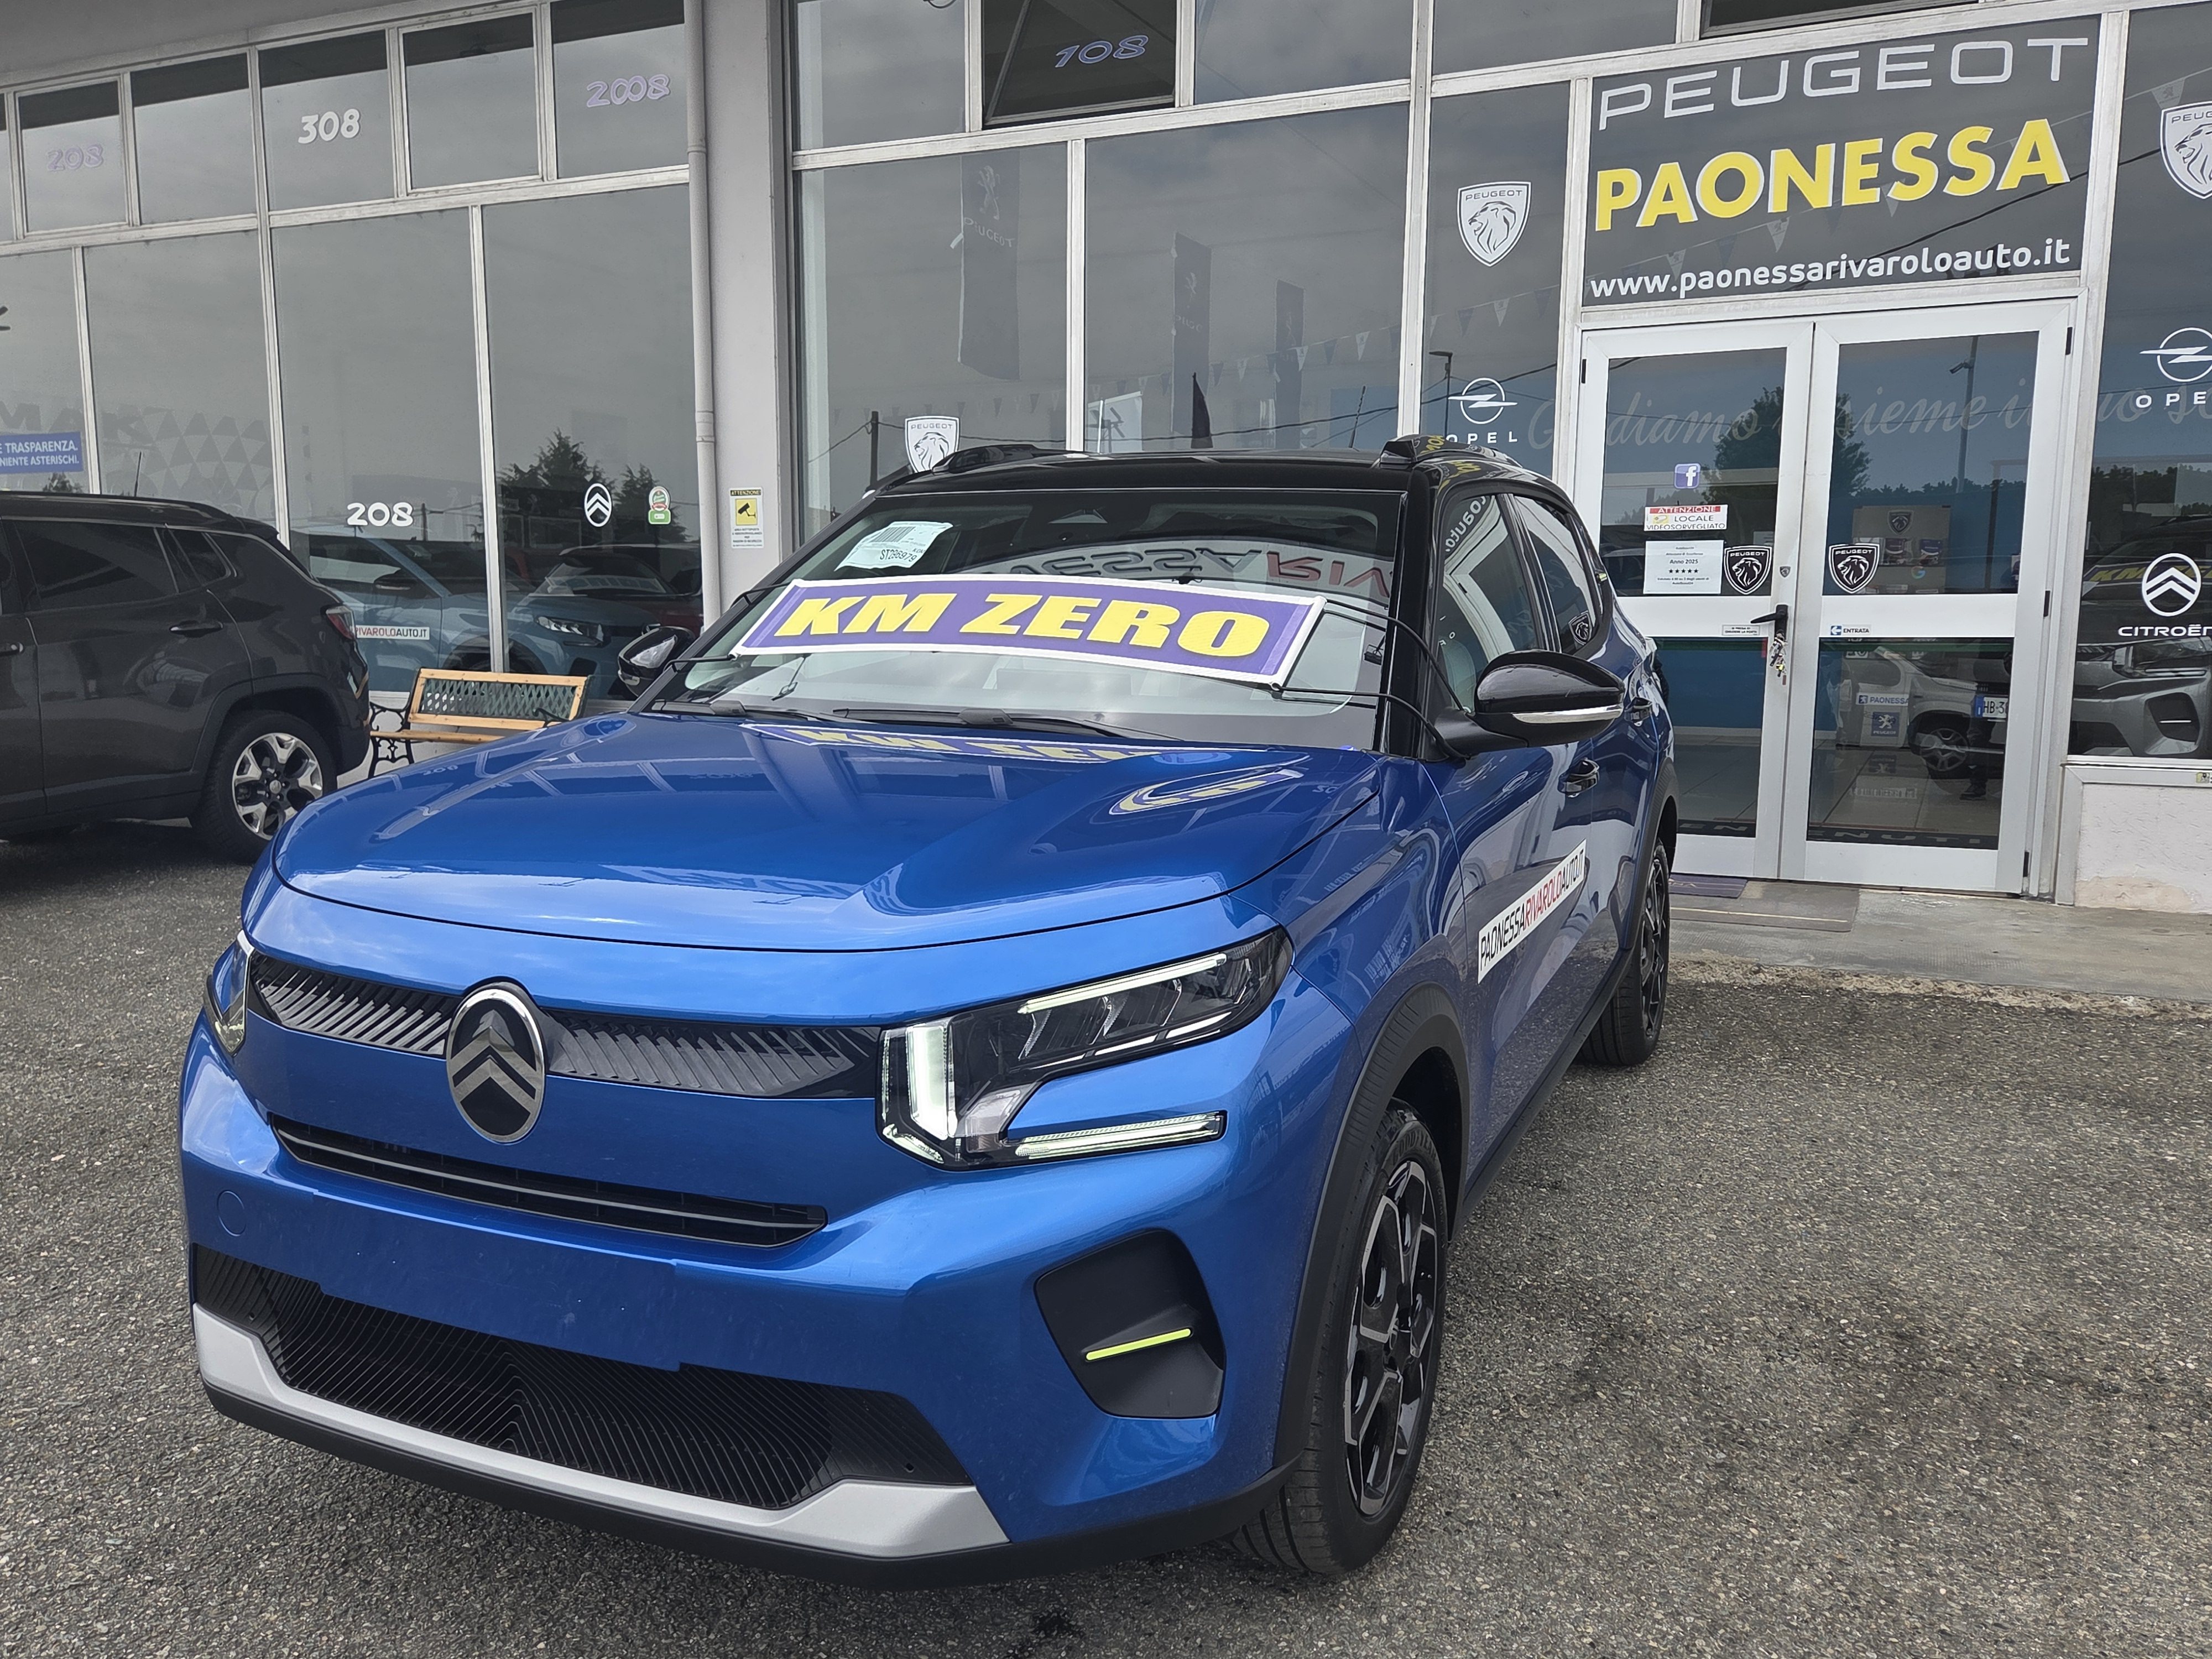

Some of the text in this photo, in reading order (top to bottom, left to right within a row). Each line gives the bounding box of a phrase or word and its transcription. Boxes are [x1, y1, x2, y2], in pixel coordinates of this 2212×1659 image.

[1055, 34, 1149, 69] 108
[586, 74, 671, 108] 2008
[1598, 37, 2089, 131] PEUGEOT
[298, 108, 361, 144] 308
[46, 143, 104, 171] 208
[1595, 118, 2070, 232] PAONESSA
[1465, 190, 1522, 201] PEUGEOT
[1590, 238, 2070, 299] www.paonessarivaroloauto.it
[4, 440, 78, 453] TRASPARENZA.
[1446, 431, 1517, 444] OPEL
[30, 455, 79, 466] ASTERISCHI.
[347, 502, 414, 527] 208
[774, 593, 1270, 657] KM ZERO
[1480, 849, 1584, 971] PAONESSARIVAROLOAUTO.IT
